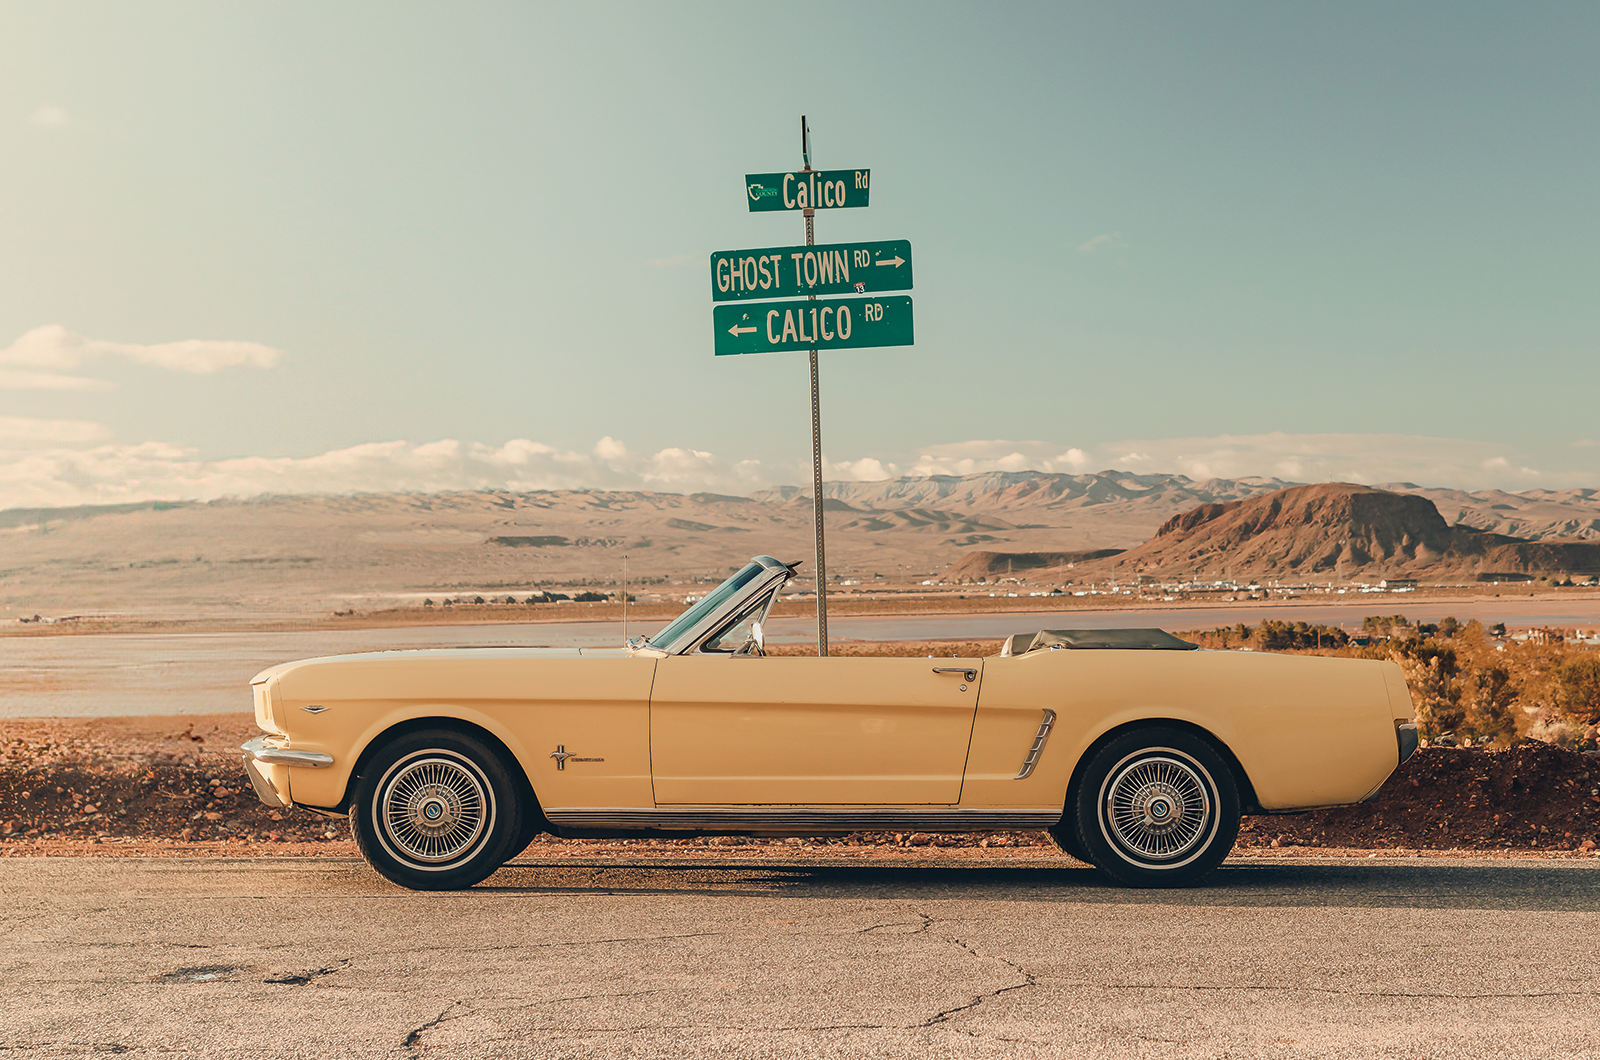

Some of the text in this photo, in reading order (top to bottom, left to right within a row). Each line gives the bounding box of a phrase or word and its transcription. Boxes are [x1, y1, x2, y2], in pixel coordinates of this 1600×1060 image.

[783, 171, 868, 208] Calico Rd
[716, 249, 871, 292] GHOST TOWN RD
[766, 303, 883, 344] CALICO RD
